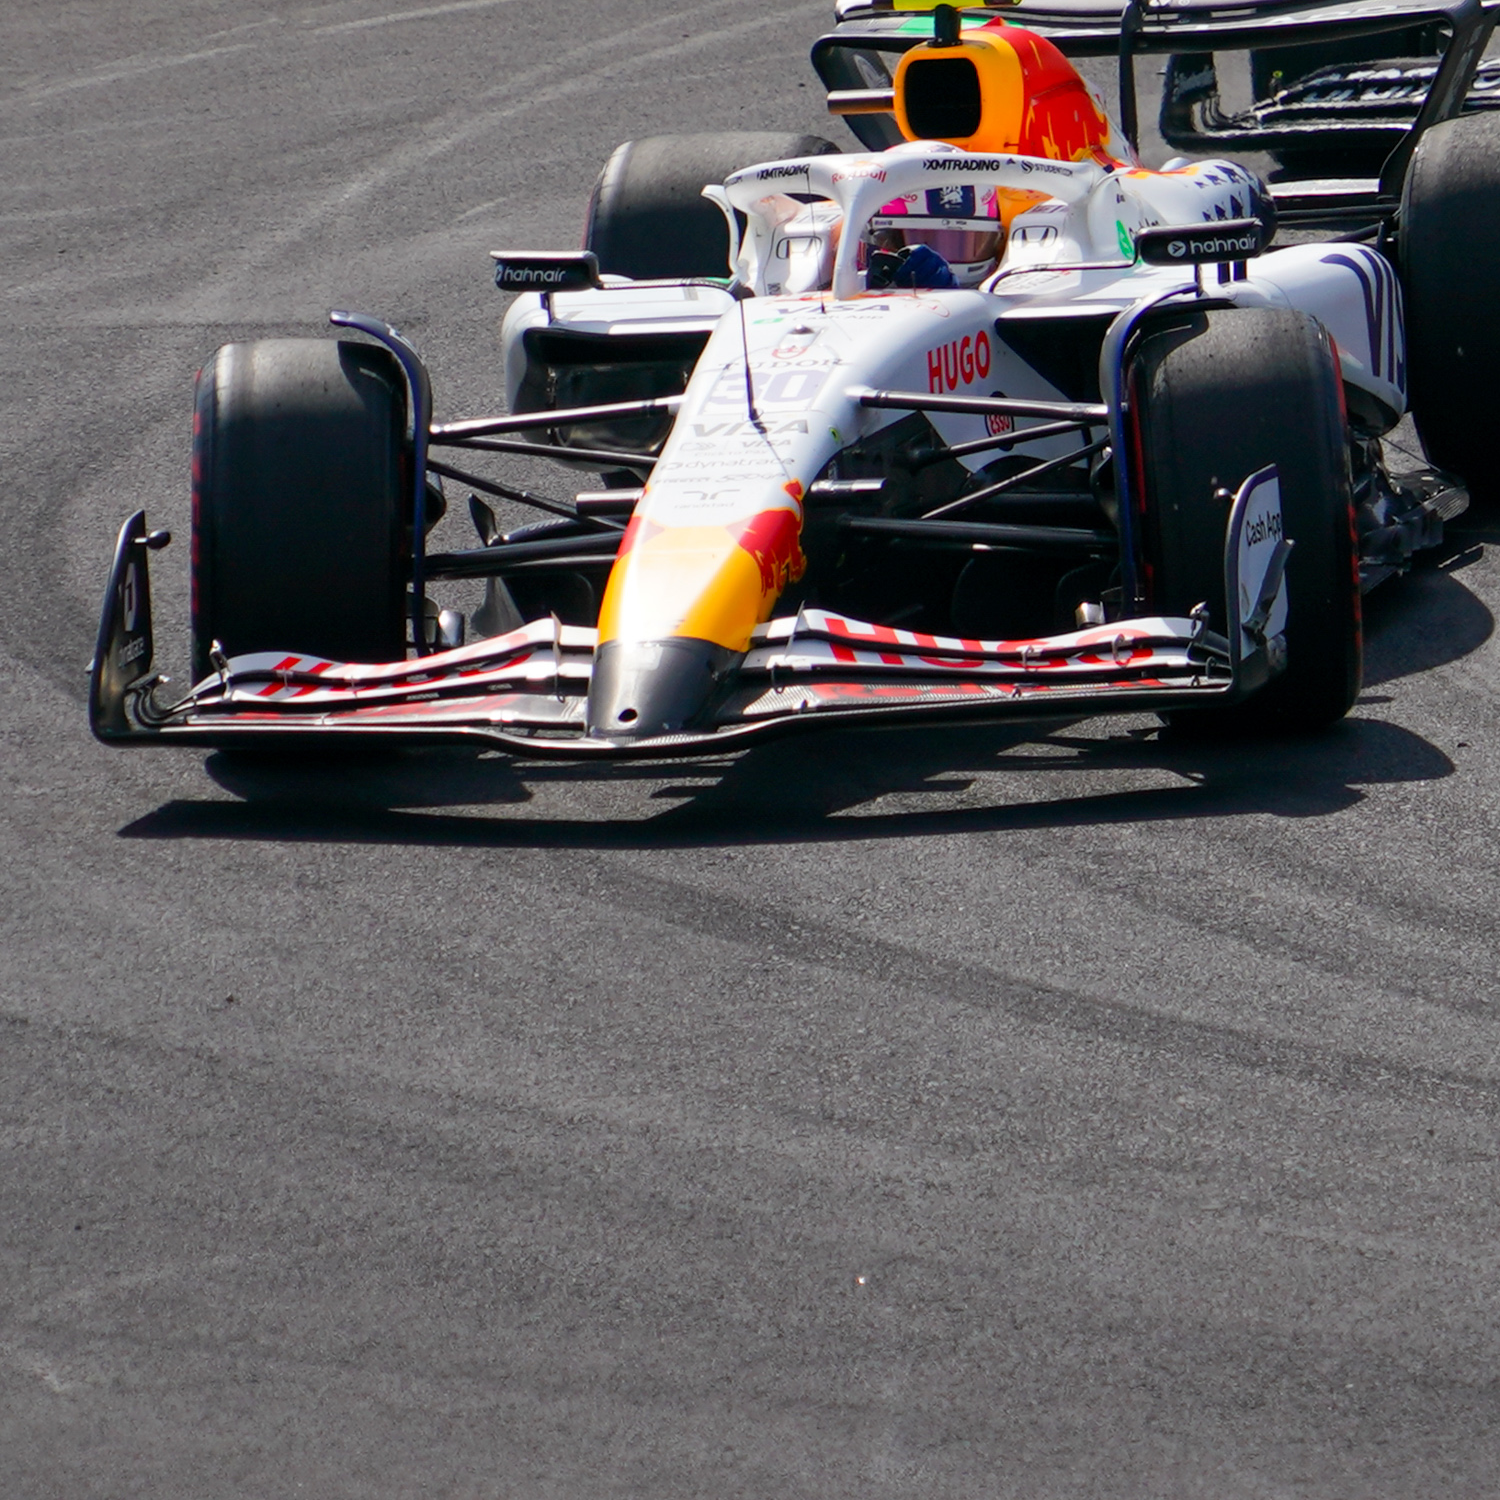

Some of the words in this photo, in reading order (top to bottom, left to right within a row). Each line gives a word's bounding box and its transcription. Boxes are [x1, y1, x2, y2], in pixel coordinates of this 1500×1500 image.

[925, 158, 1001, 172] XMTRADING
[1190, 233, 1257, 255] hahnair
[504, 266, 567, 283] hahnair
[778, 304, 890, 315] VISA
[719, 357, 853, 370] TUDOR
[927, 330, 990, 394] HUGO
[691, 419, 810, 437] VISA
[741, 439, 792, 448] VISA
[684, 457, 796, 469] dynatrace
[1245, 514, 1267, 548] Cash
[825, 617, 1154, 668] HUGO
